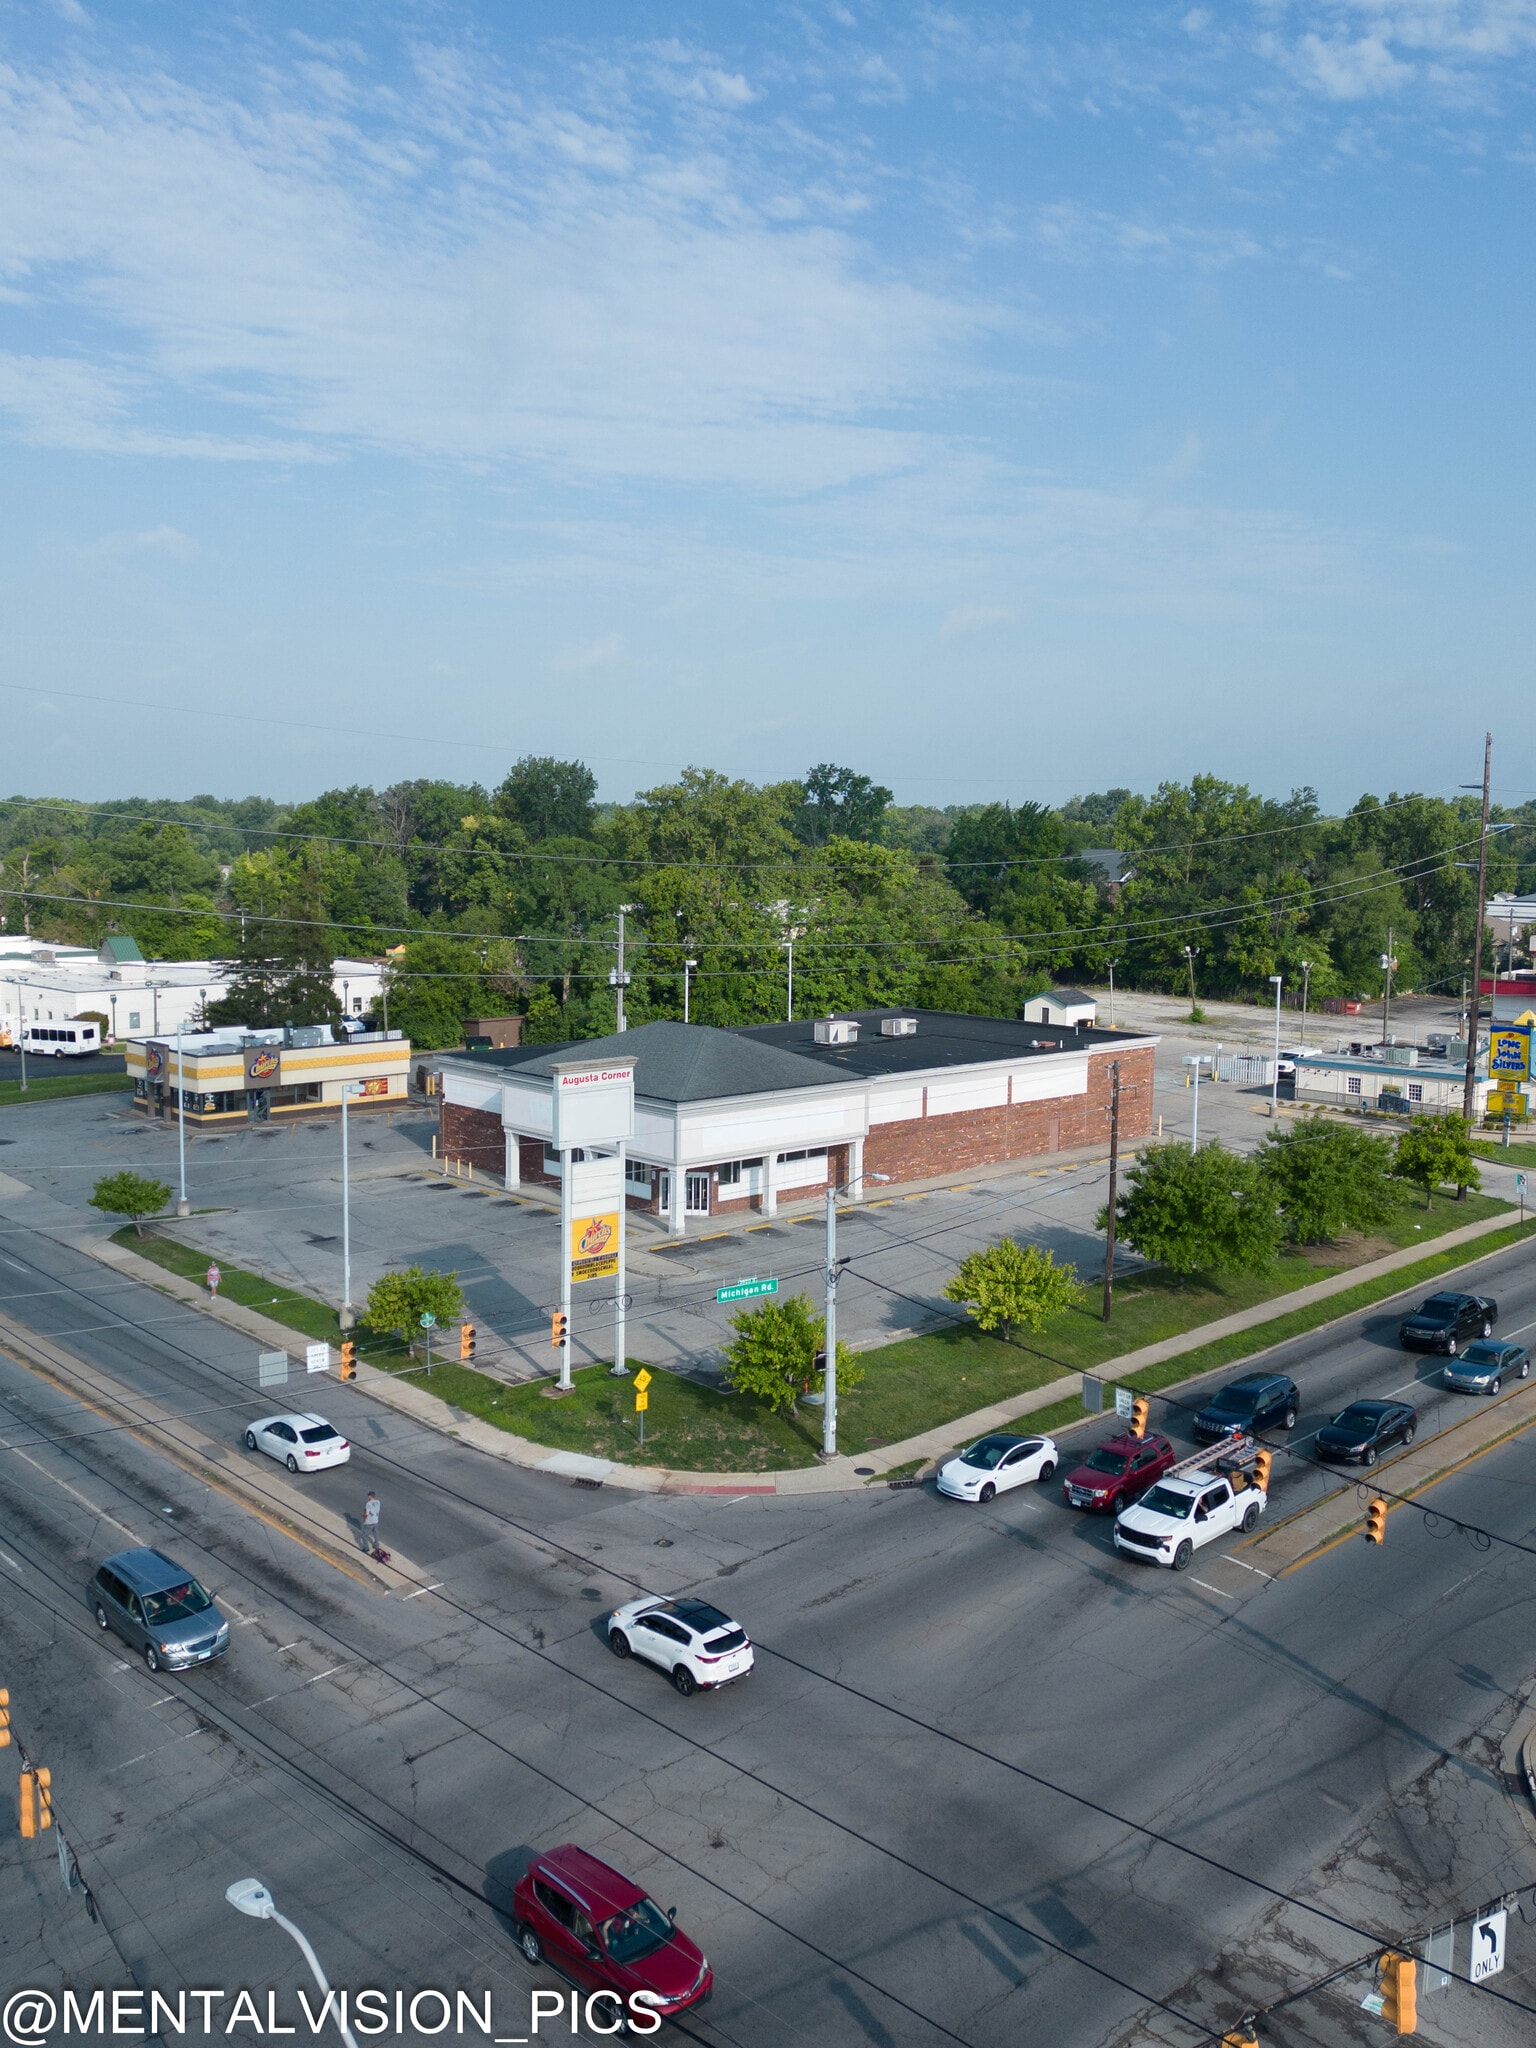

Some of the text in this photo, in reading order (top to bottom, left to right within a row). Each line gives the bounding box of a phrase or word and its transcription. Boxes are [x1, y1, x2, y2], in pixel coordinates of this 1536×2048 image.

[1497, 1039, 1521, 1049] LONG
[562, 1071, 631, 1086] Augusta Corner
[720, 1287, 759, 1300] Michigan
[1475, 1954, 1500, 1978] ONLY
